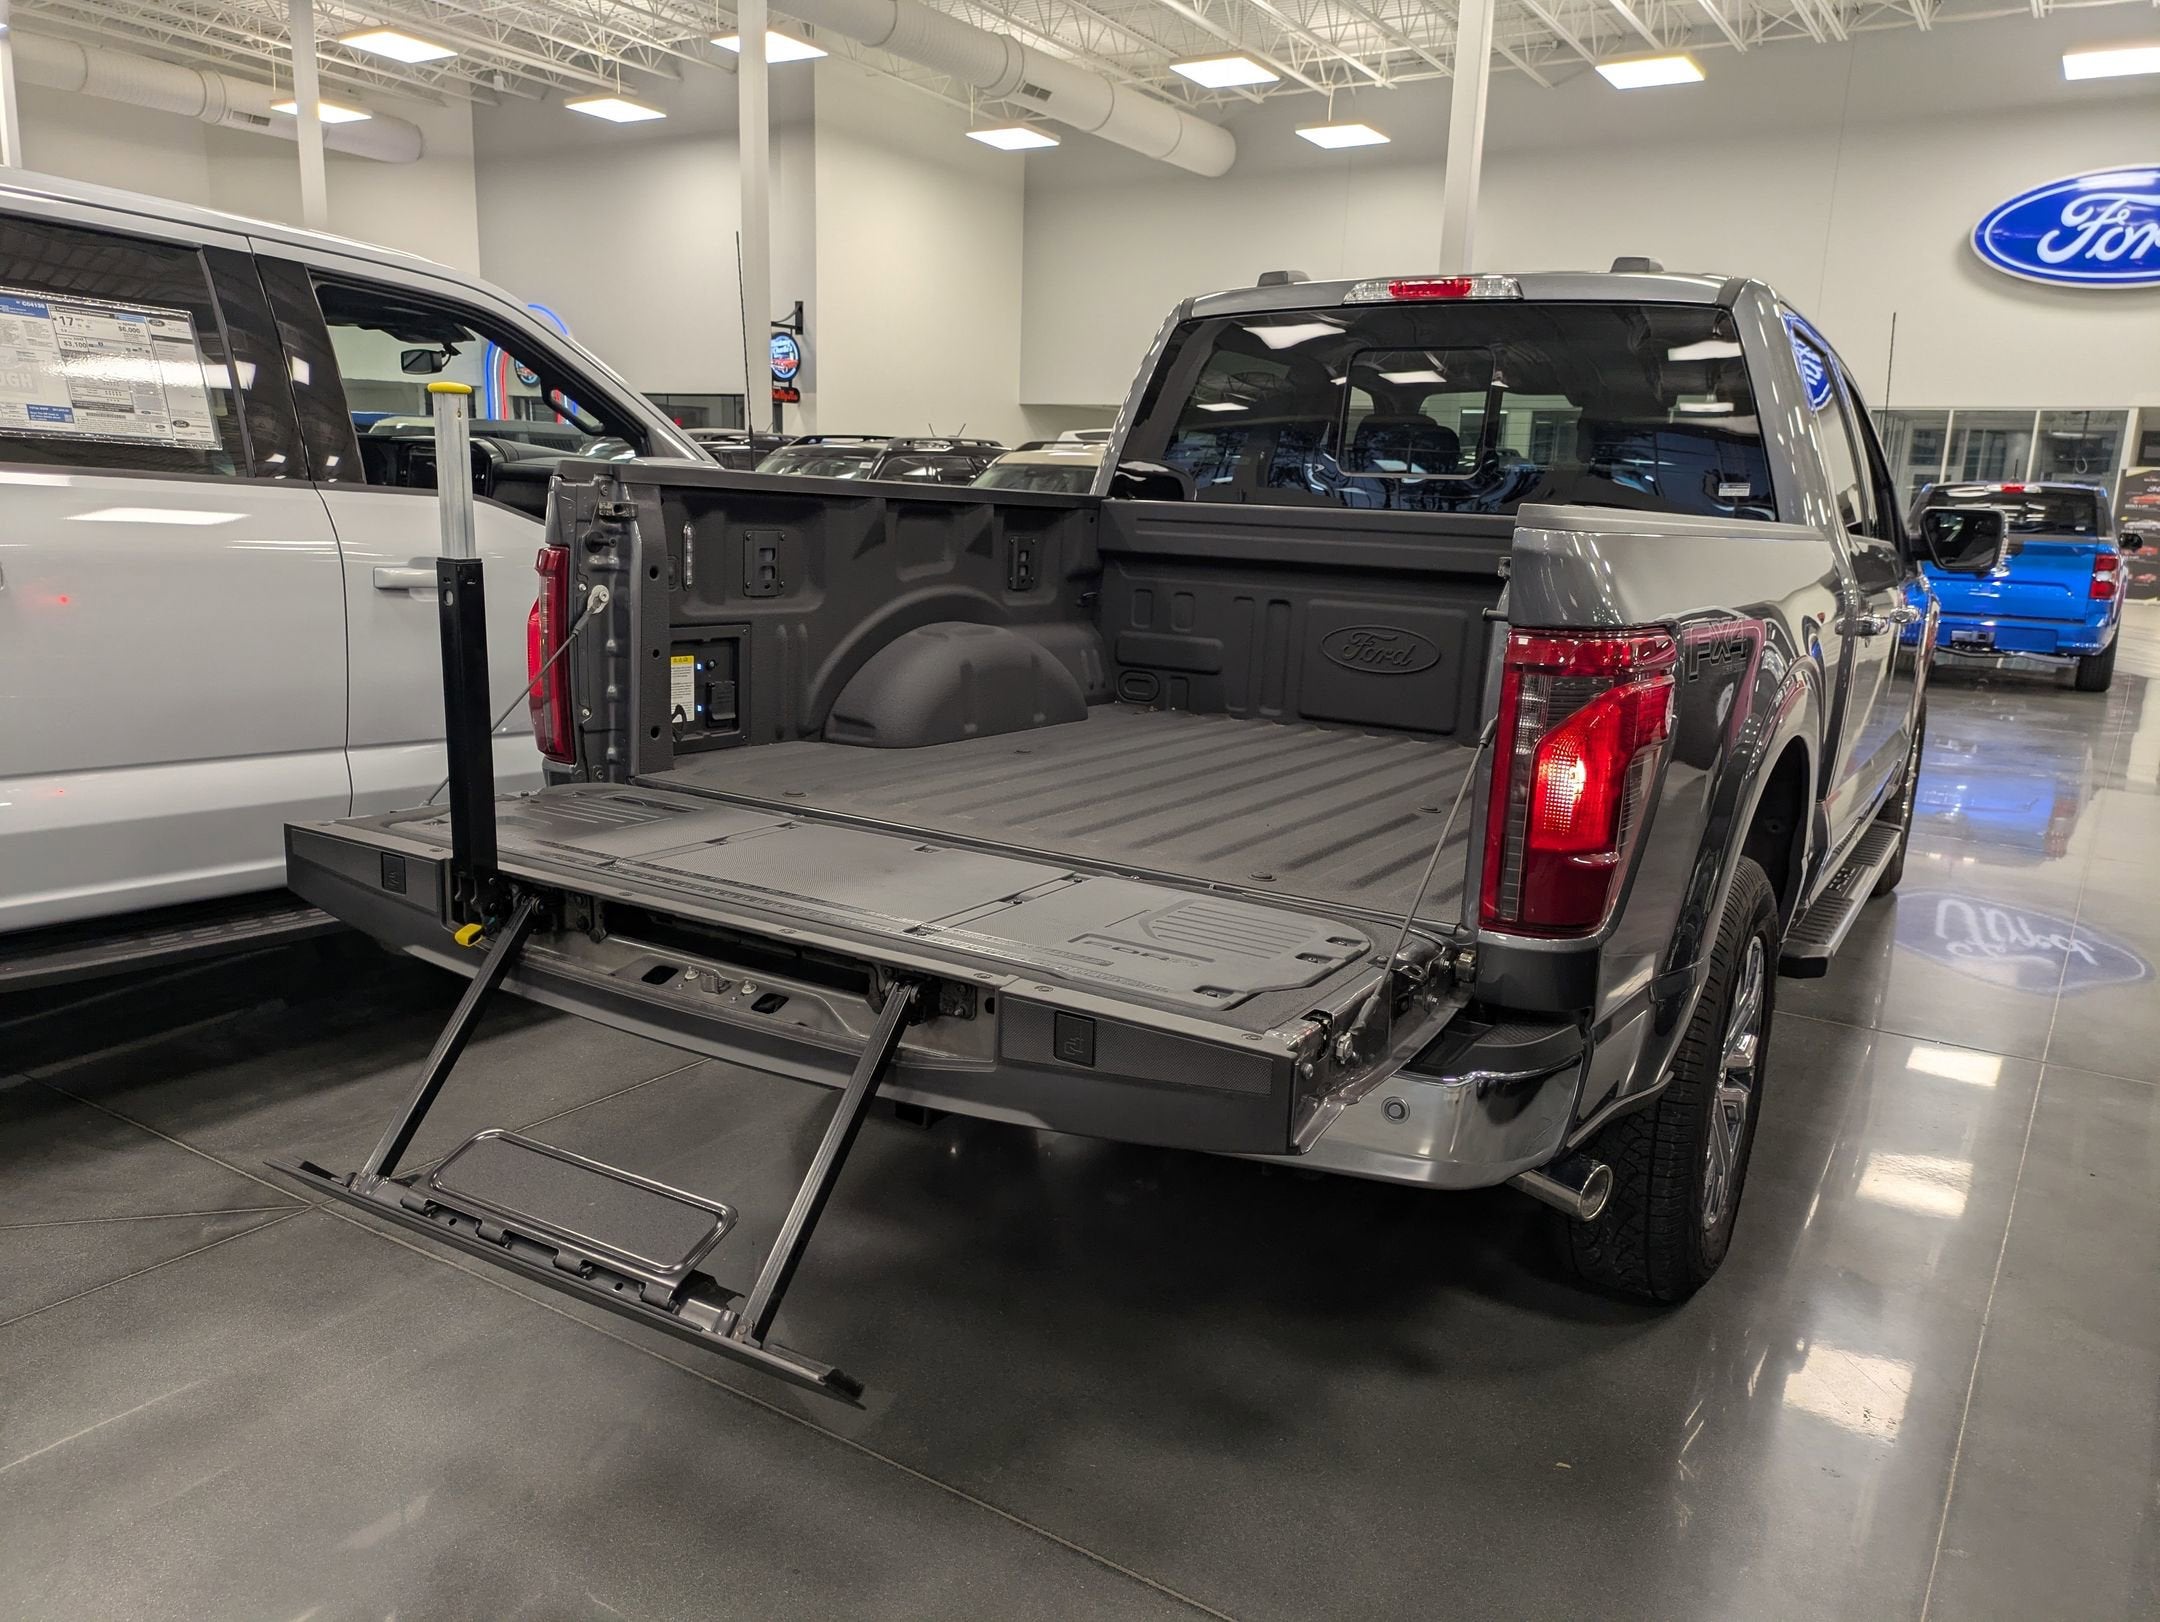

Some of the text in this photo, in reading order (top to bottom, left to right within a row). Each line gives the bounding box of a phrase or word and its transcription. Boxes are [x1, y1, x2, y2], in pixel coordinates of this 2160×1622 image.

[59, 315, 74, 327] 17
[1343, 631, 1417, 666] Ford
[1684, 616, 1747, 682] FX4
